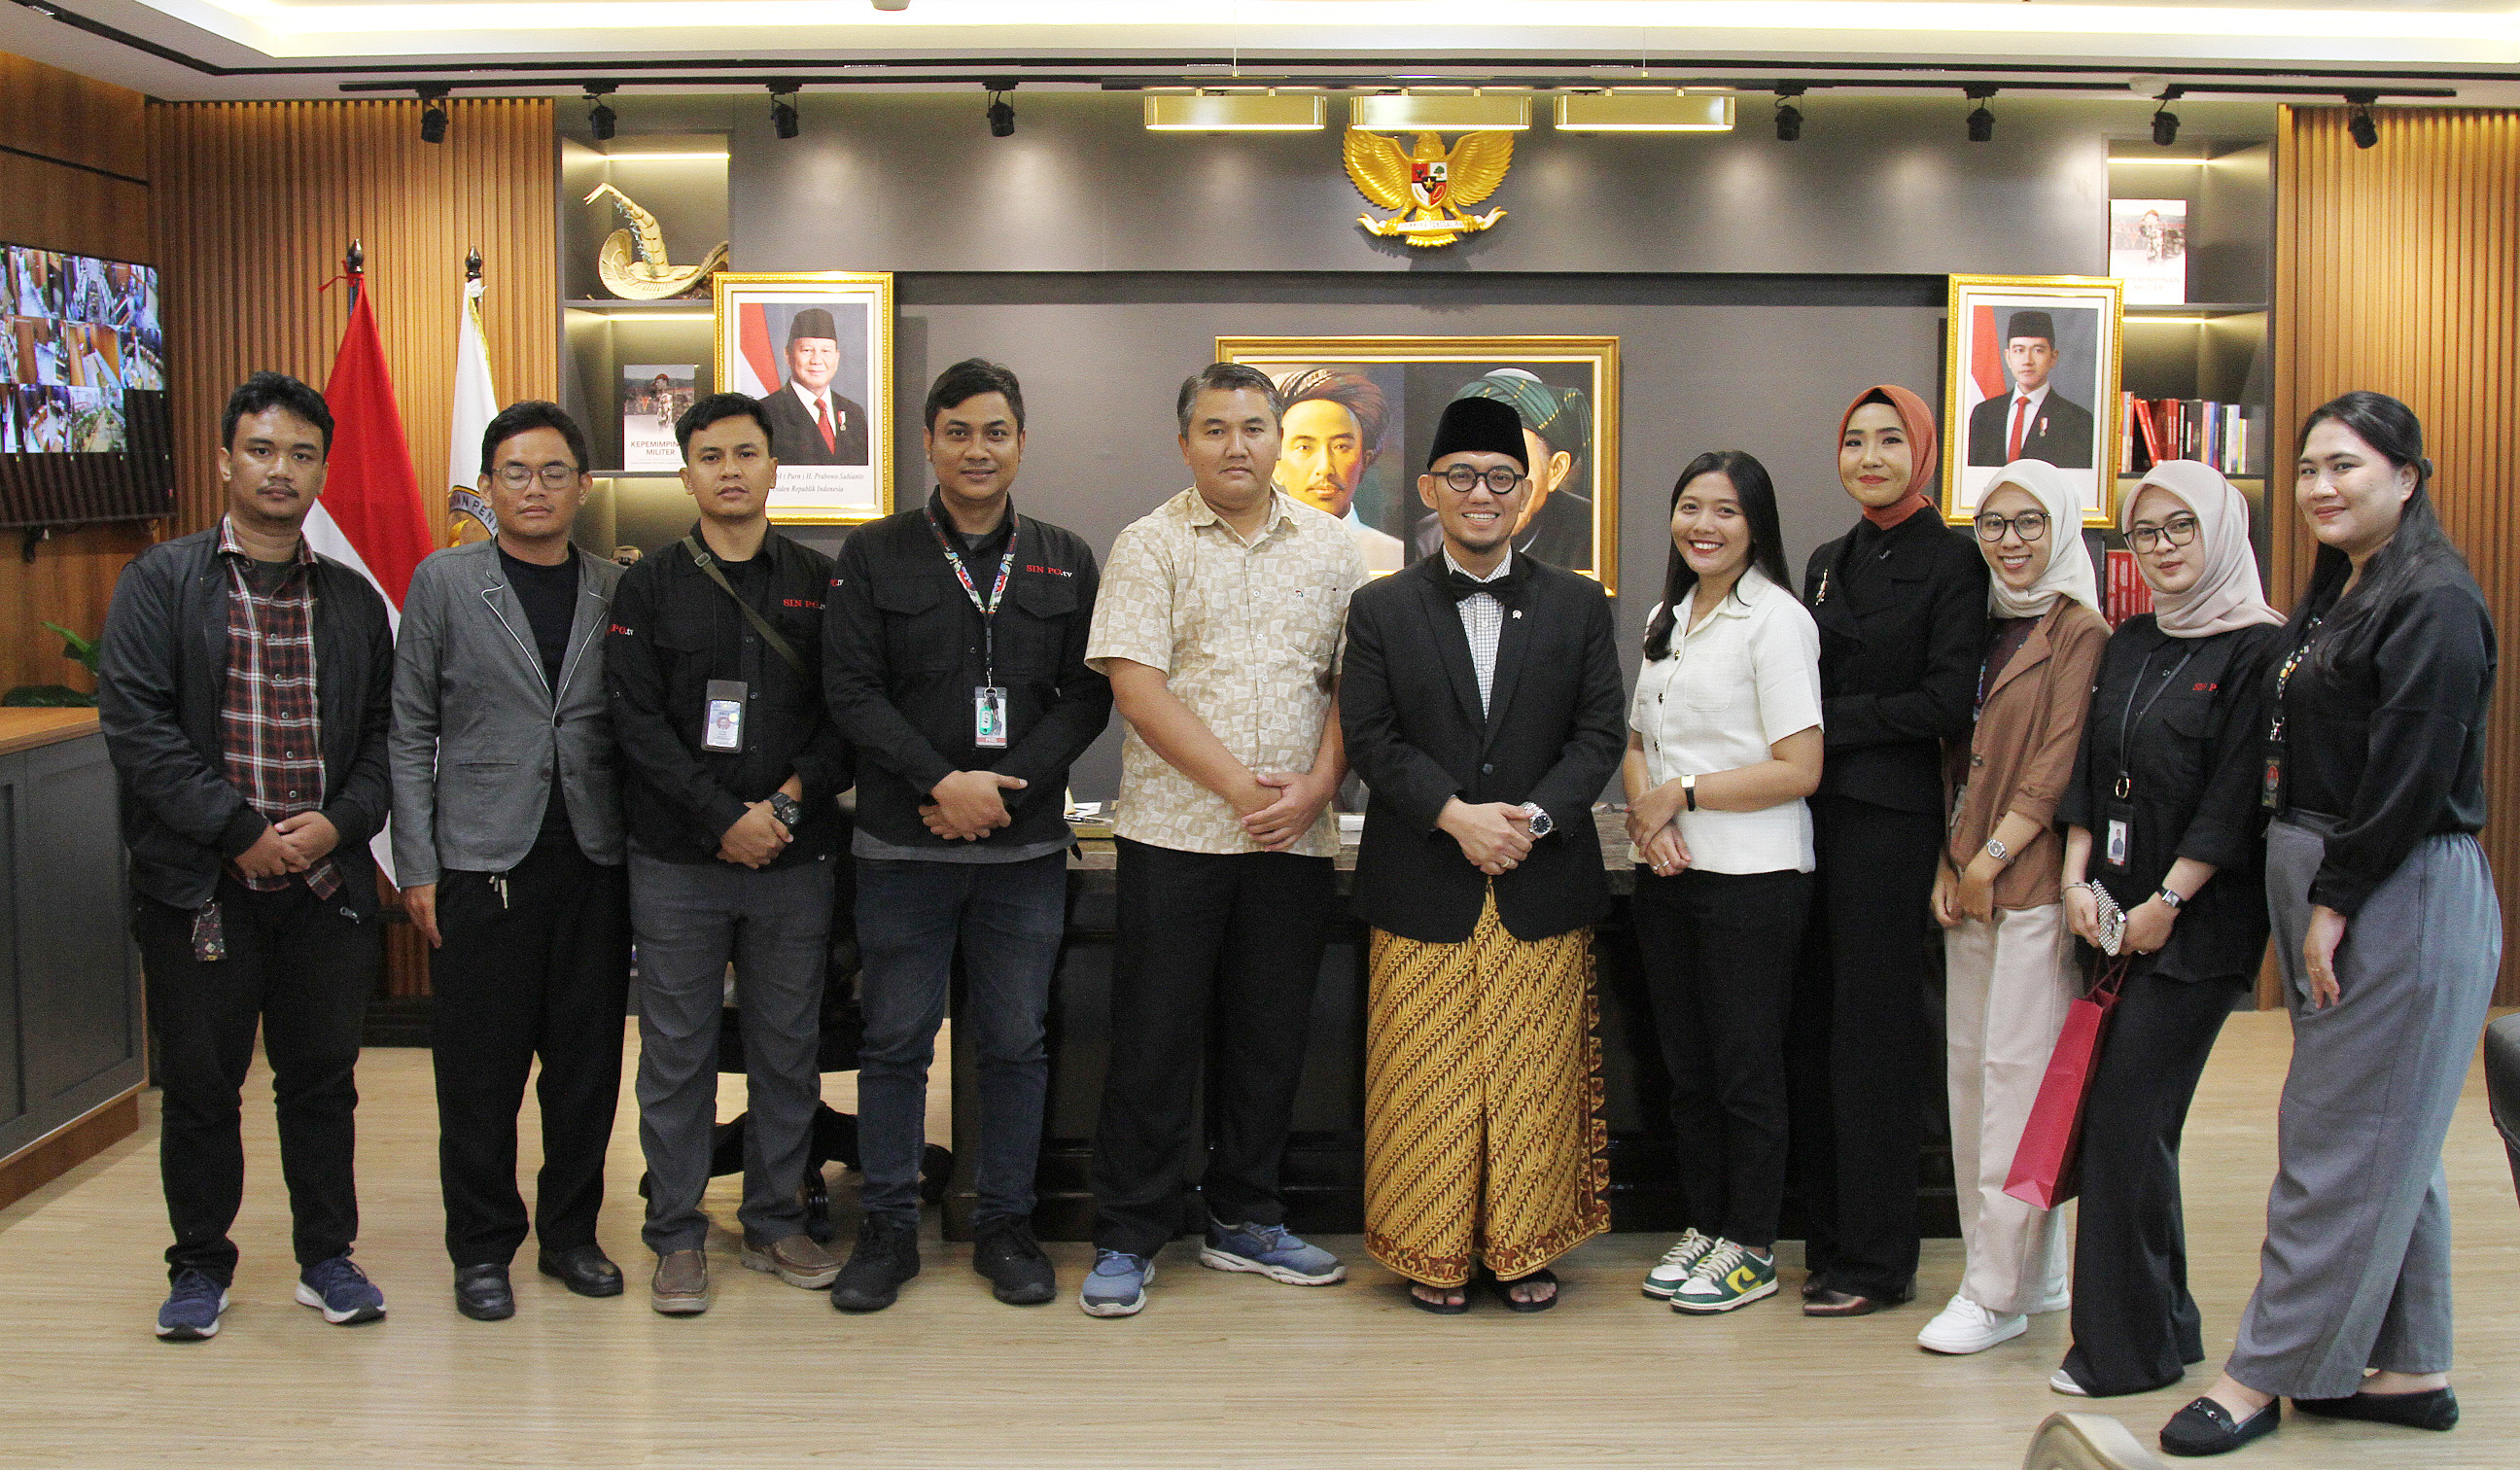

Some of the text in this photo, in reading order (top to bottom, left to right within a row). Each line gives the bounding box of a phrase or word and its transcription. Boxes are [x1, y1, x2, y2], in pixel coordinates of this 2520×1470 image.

[791, 485, 816, 495] Republik
[1026, 564, 1072, 578] SIN PO.tv
[783, 598, 803, 608] SIN
